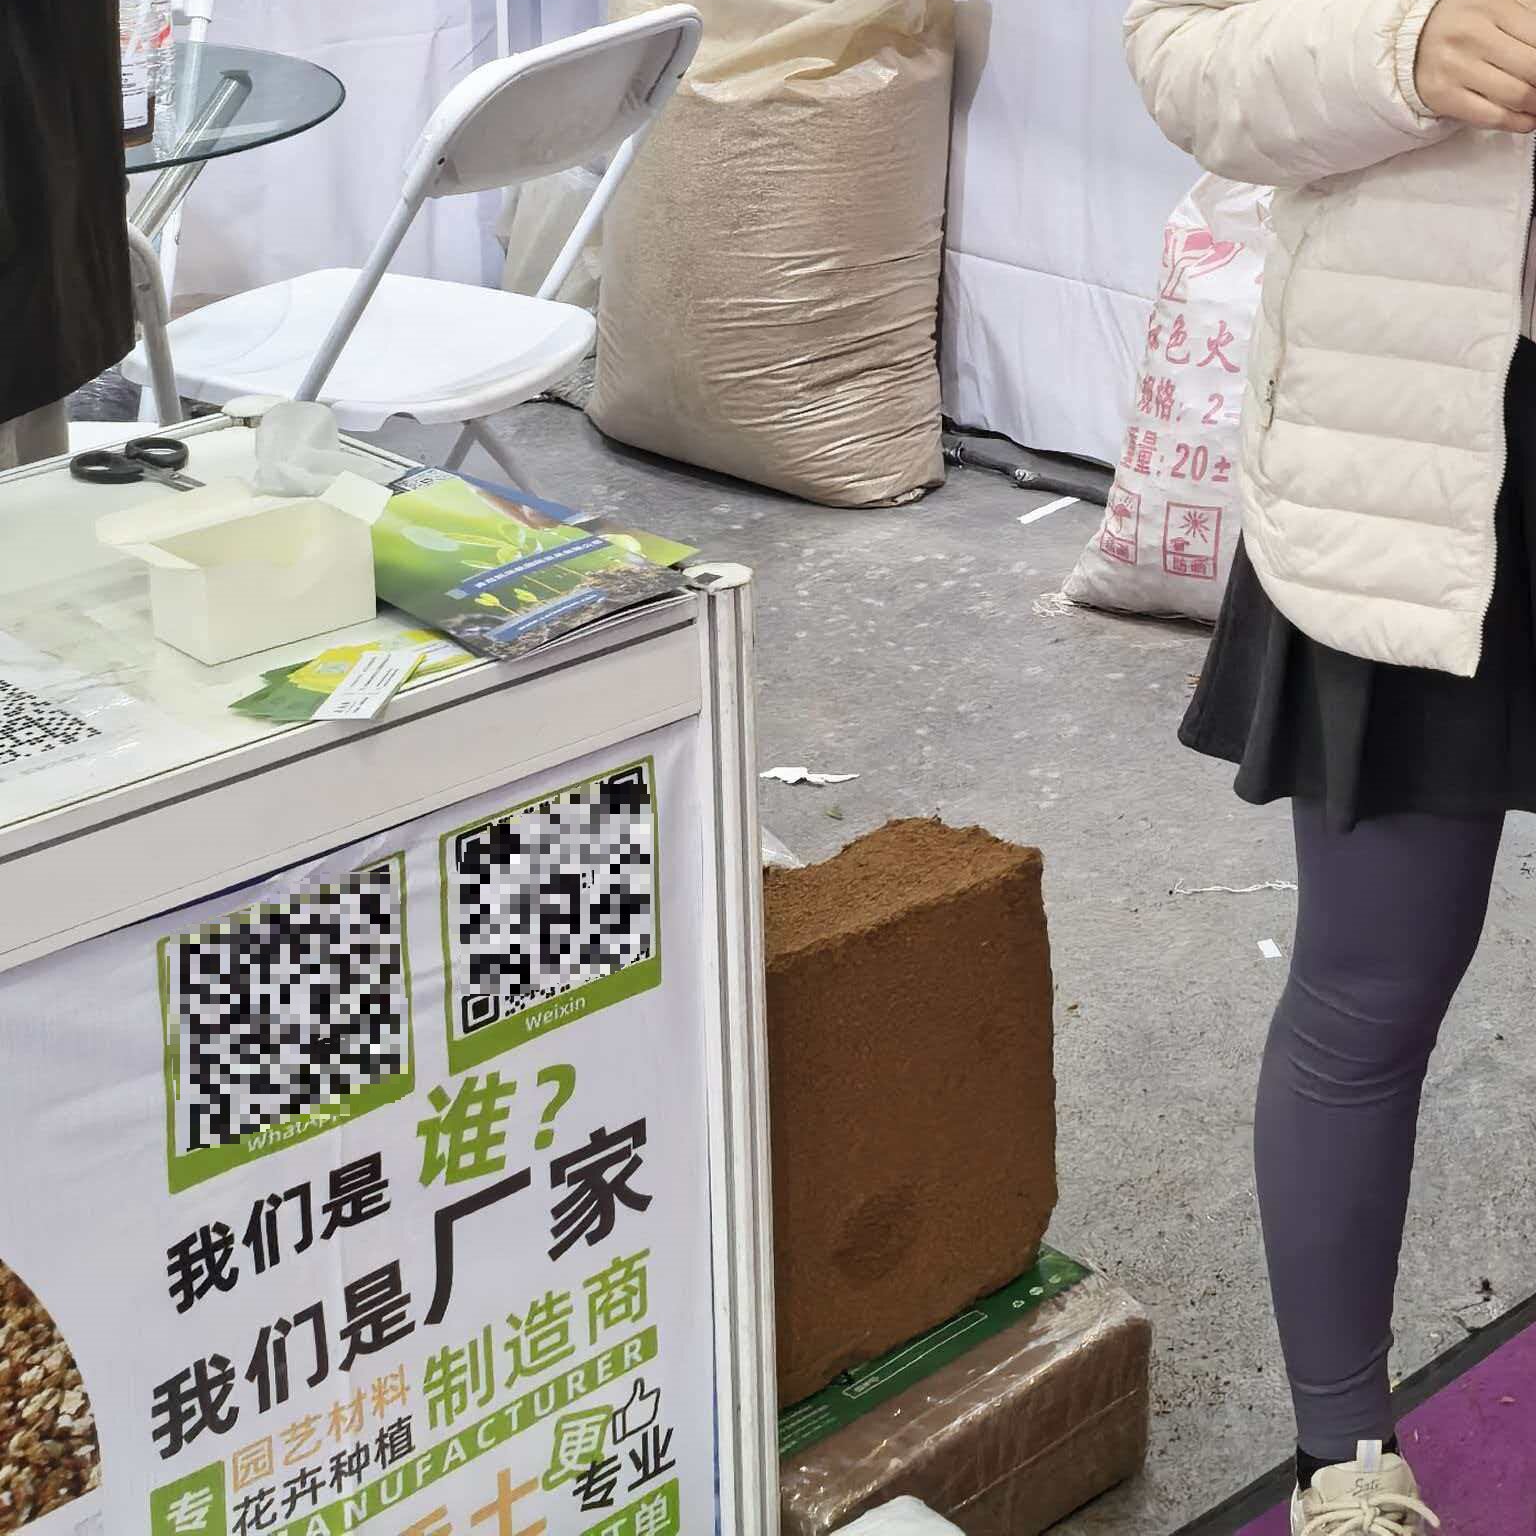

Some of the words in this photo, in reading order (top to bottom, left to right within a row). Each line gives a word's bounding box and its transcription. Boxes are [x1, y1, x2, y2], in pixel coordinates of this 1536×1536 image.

[525, 996, 587, 1031] Weixin
[167, 1151, 392, 1314] 我们是
[416, 1063, 576, 1190] 谁？
[151, 1260, 415, 1461] 我们是
[424, 1117, 654, 1326] 厂家
[232, 1365, 411, 1494] 园艺材料
[424, 1248, 651, 1430] 制造商
[167, 1487, 213, 1532] 专
[232, 1414, 416, 1536] 花卉种植
[573, 1424, 676, 1512] 专业
